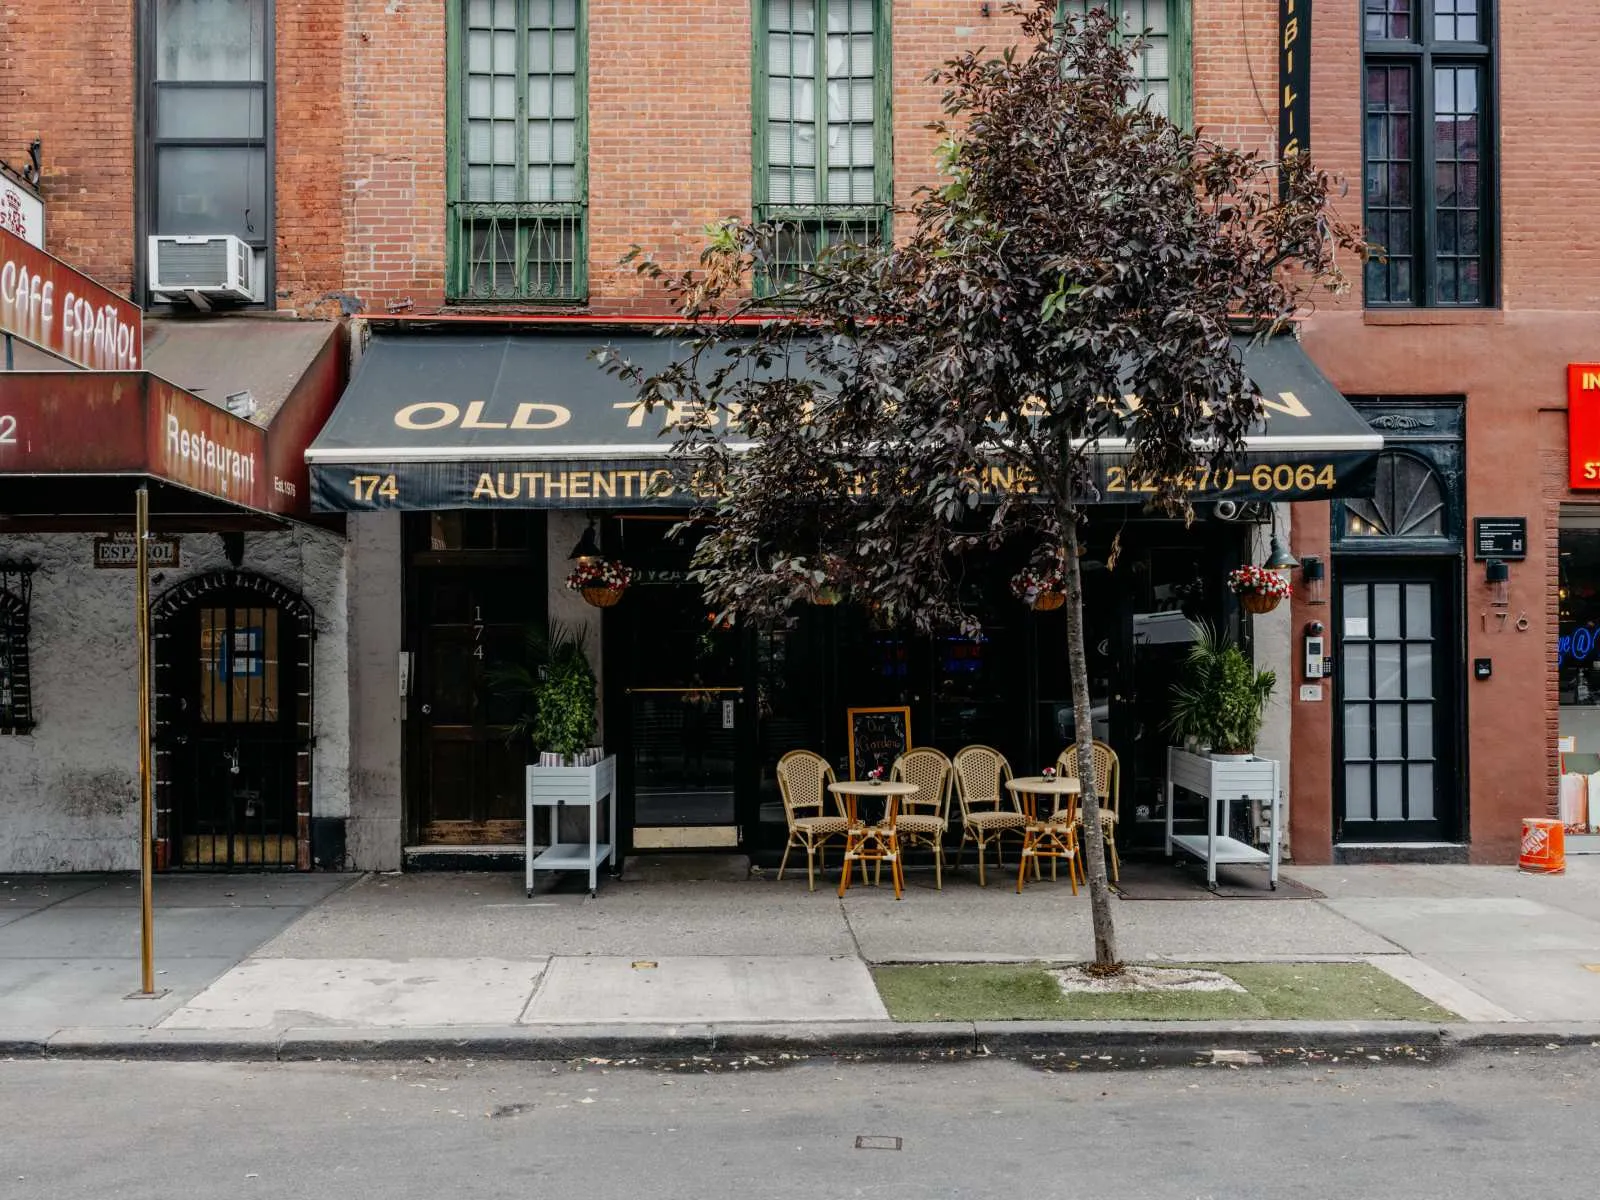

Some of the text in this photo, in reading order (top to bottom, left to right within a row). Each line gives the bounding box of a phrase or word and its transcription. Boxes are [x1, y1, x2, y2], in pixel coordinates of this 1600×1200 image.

[2, 261, 136, 362] CAFE ESPAÑOL
[394, 401, 571, 430] OLD
[167, 413, 254, 483] Restaurant
[348, 474, 399, 501] 174
[472, 470, 674, 499] AUTHENTIC
[1584, 462, 1600, 479] S
[473, 605, 485, 660] 174
[1480, 610, 1529, 632] 176
